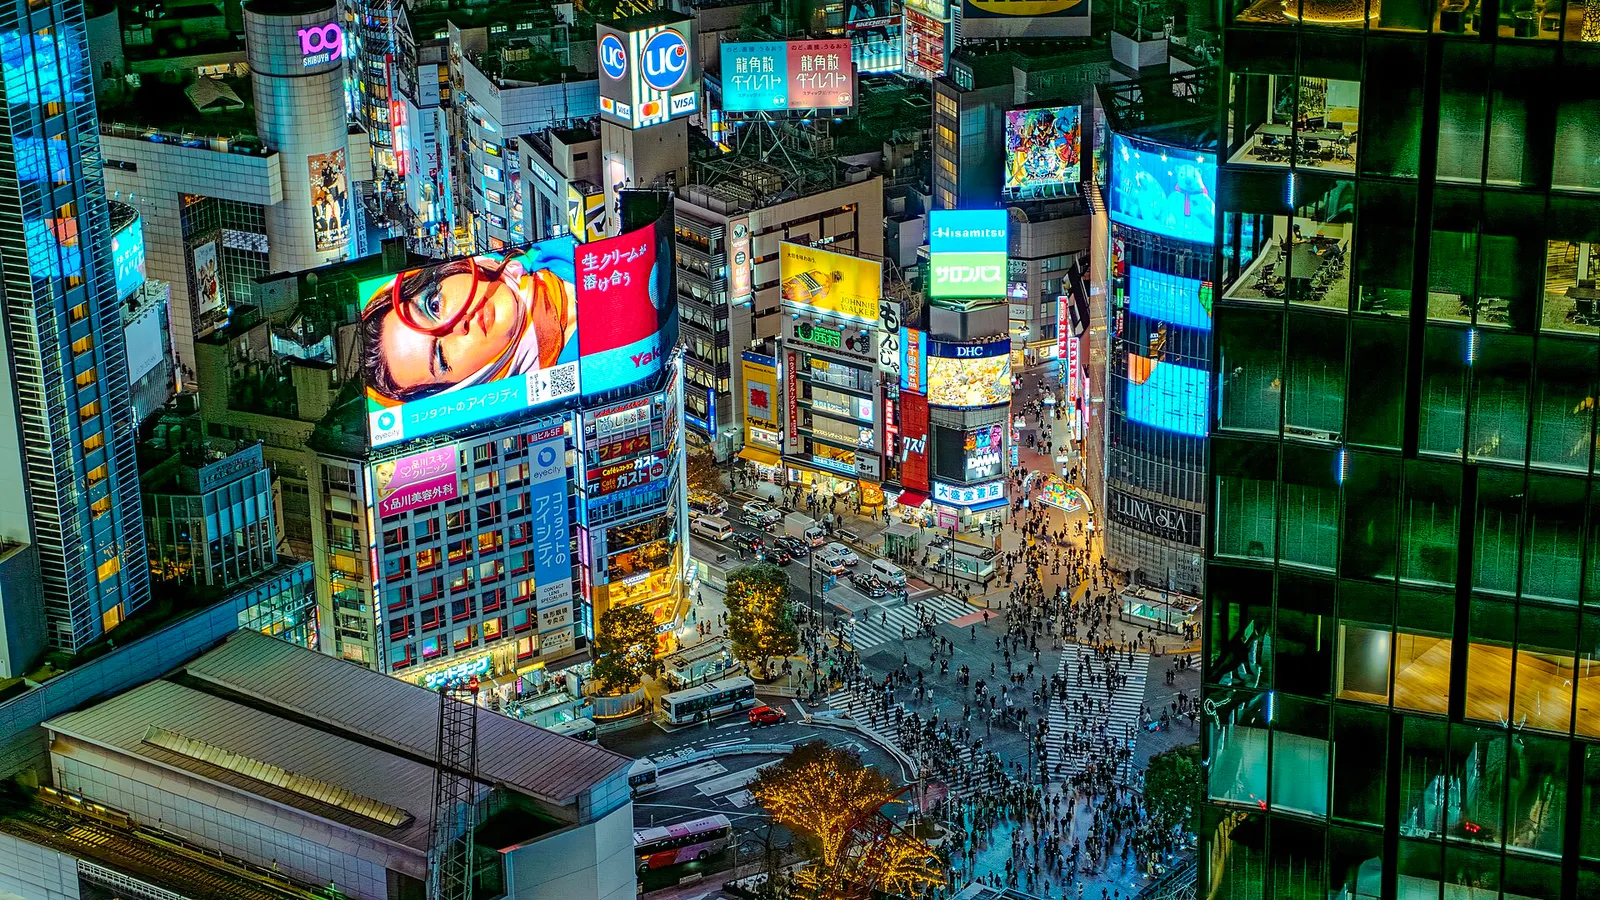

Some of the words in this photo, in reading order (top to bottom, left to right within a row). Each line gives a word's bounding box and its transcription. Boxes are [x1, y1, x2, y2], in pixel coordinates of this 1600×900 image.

[298, 23, 342, 60] 109
[303, 53, 329, 66] SHIBUYA
[736, 55, 774, 73] 龍角散
[801, 53, 839, 71] 龍角散
[731, 73, 782, 91] ダイレクト
[796, 72, 847, 89] ダイレクト
[618, 105, 629, 116] VISA
[673, 96, 694, 109] VISA
[932, 226, 1006, 238] Hisamitsu
[581, 243, 647, 272] 生クリームが
[583, 269, 631, 292] 溶け合う
[935, 265, 1003, 284] サロンパス
[840, 304, 876, 318] WALKER
[841, 296, 876, 311] JOHNNIE
[814, 331, 841, 349] 西村
[957, 346, 984, 357] DHC
[907, 332, 918, 389] 三千里薬品
[411, 387, 519, 425] コンタクトのアイシティ
[374, 429, 400, 441] eyecity
[585, 424, 596, 435] 9F
[412, 452, 451, 470] 品川スキン
[634, 454, 661, 470] ガスト
[967, 453, 1000, 470] DMM
[412, 462, 448, 479] クリニック
[534, 466, 562, 480] eyecity
[617, 469, 648, 489] ガスト
[975, 465, 992, 478] TV
[588, 483, 600, 494] 7F
[602, 478, 616, 488] Café
[391, 483, 453, 511] 品川美容外科
[939, 484, 999, 501] 大盛堂書店
[1117, 494, 1153, 524] LUNA
[1155, 508, 1188, 533] SEA
[535, 495, 553, 568] アイシティ
[553, 492, 566, 564] コンタクトの
[544, 583, 564, 592] CONTACT
[541, 592, 568, 604] SPECIALISTS
[425, 656, 491, 689] サンドラッグ
